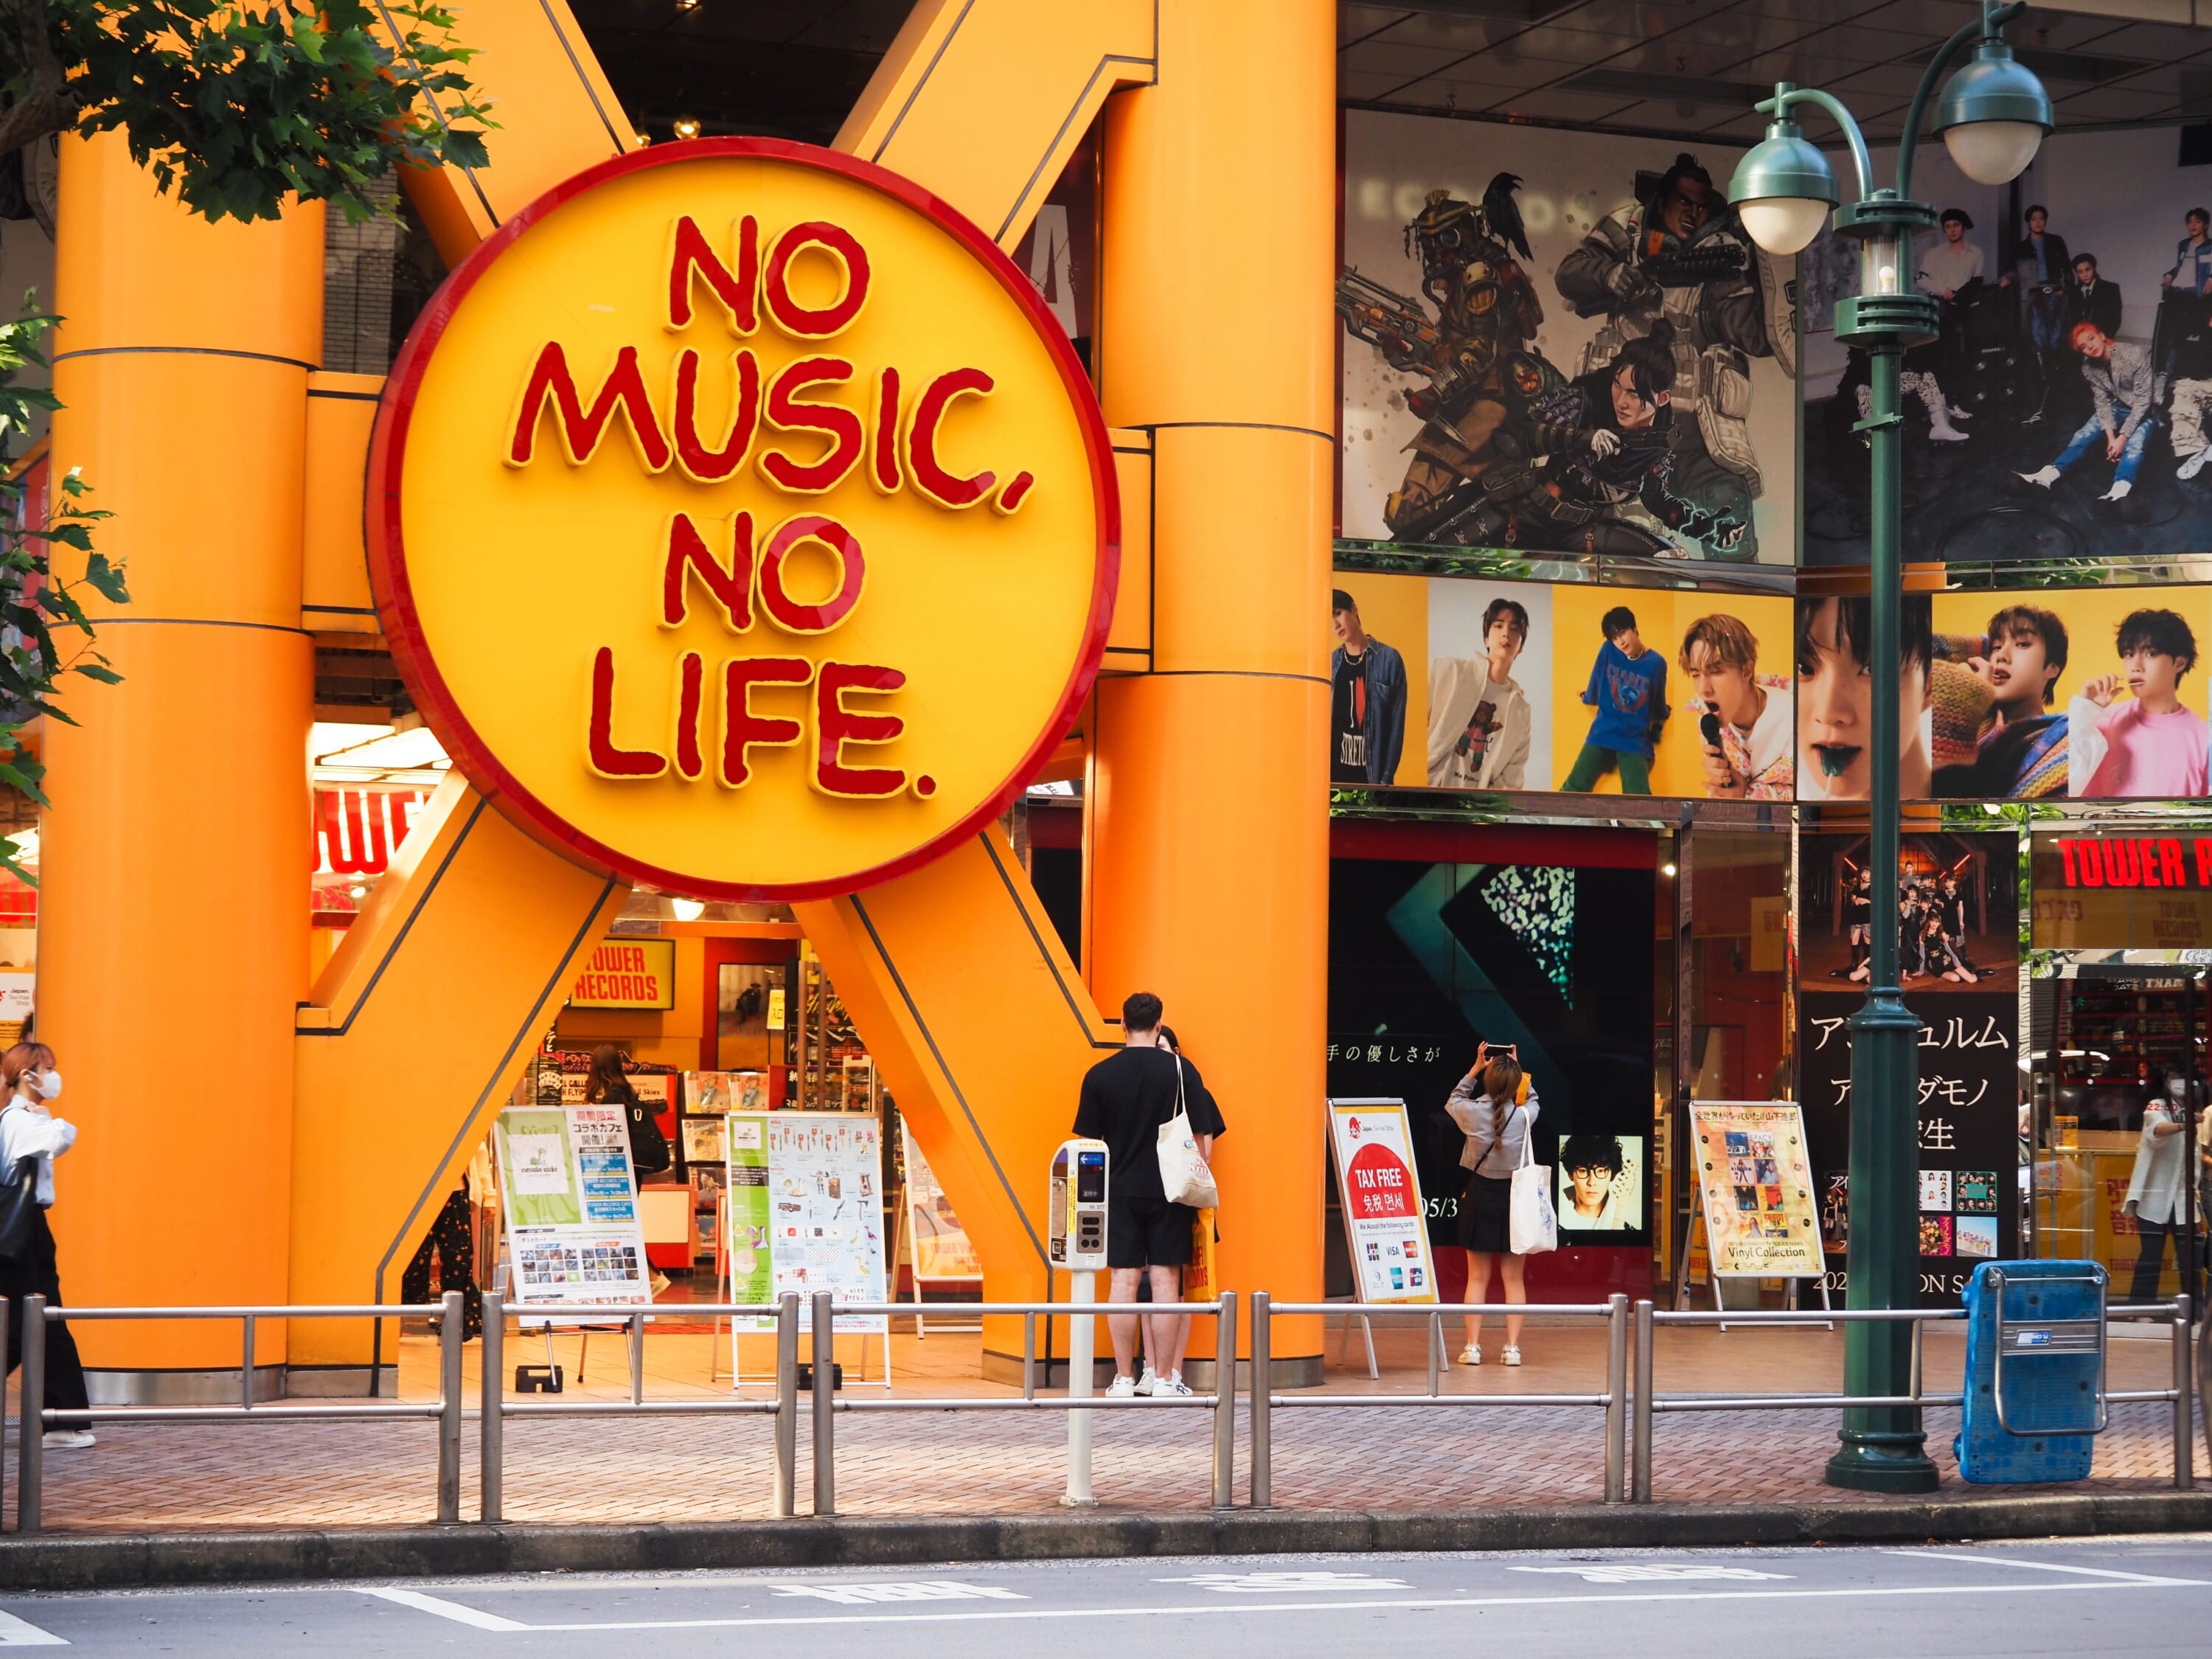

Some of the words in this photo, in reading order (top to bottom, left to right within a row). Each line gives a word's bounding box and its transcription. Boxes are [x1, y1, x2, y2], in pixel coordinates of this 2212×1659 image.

[667, 214, 872, 340] NO
[503, 339, 1035, 516] MUSIC,
[658, 509, 866, 636] NO
[1349, 680, 1354, 728] I
[587, 645, 938, 801] LIFE.
[1340, 731, 1367, 767] STRETC
[2057, 838, 2186, 887] TOWER
[2194, 838, 2212, 887] R
[586, 946, 645, 973] OWER
[575, 974, 658, 1001] RECORDS
[771, 1008, 784, 1020] 入口
[1811, 1015, 2009, 1051] アュルム
[574, 1123, 623, 1133] コラボカフェ
[1355, 1169, 1377, 1189] TAX
[1377, 1168, 1403, 1188] FREE
[1384, 1192, 1405, 1211] 면세
[1386, 1246, 1400, 1256] VISA
[1728, 1247, 1754, 1260] Vinyl
[1756, 1246, 1805, 1257] Collection
